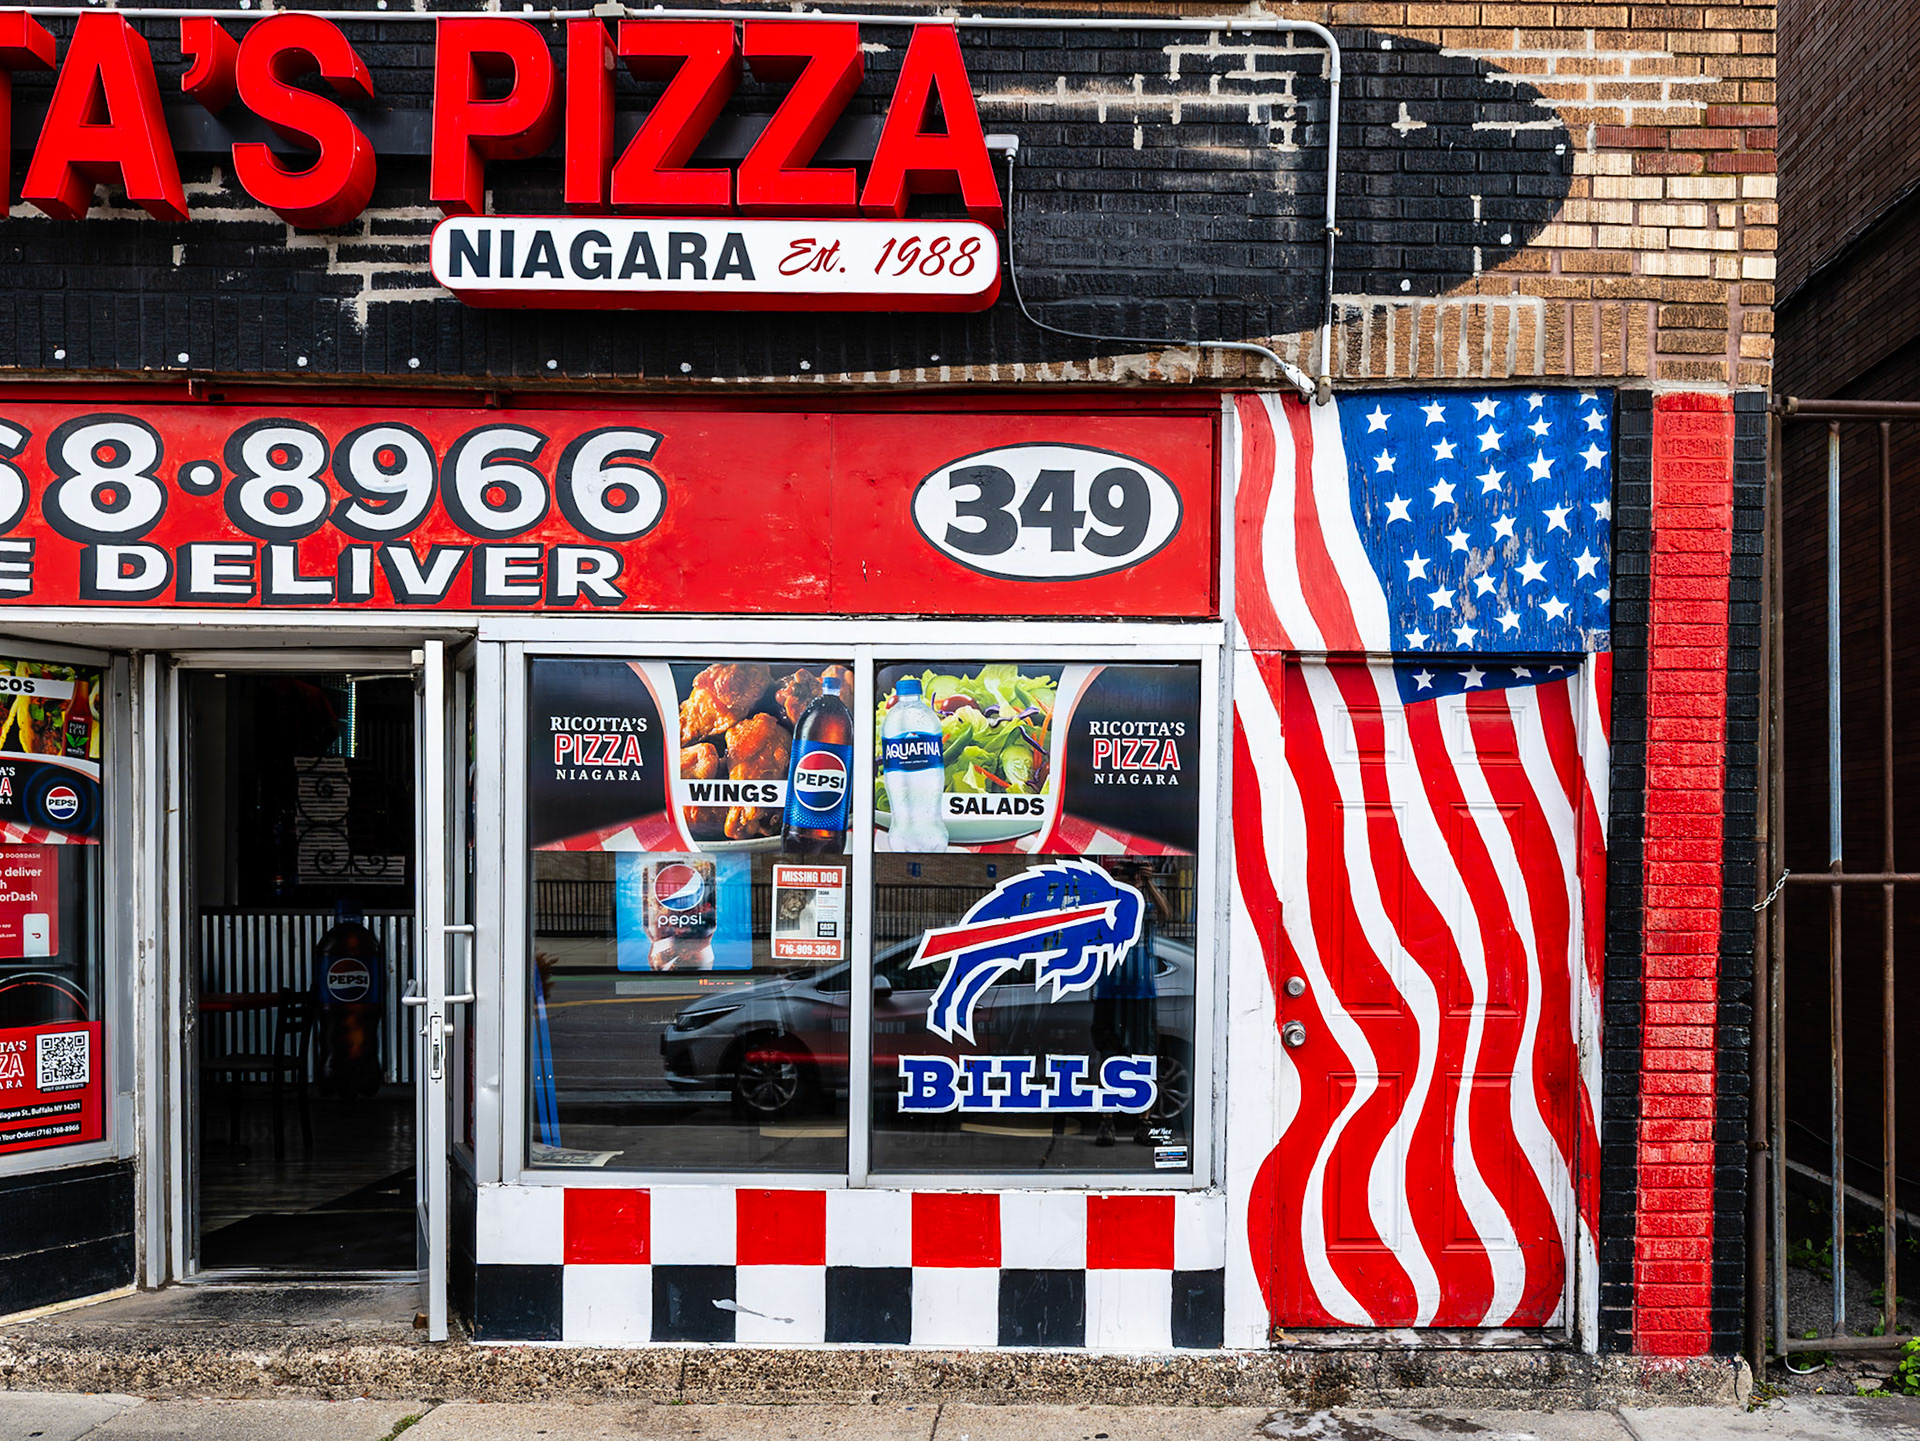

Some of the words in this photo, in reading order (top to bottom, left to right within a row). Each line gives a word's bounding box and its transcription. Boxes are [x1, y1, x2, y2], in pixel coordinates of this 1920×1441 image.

[0, 11, 377, 224] A'S
[430, 17, 1004, 218] PIZZA
[448, 228, 755, 281] NIAGARA
[778, 238, 846, 276] Est.
[873, 235, 981, 278] 1988
[944, 465, 1151, 557] 349
[79, 539, 627, 605] DELIVER
[550, 716, 647, 732] RICOTTA'S
[1089, 720, 1185, 736] RICOTTA'S
[554, 733, 643, 767] PIZZA
[886, 741, 940, 760] AQUAFINA
[1092, 738, 1181, 771] PIZZA
[556, 769, 641, 781] NIAGARA
[795, 770, 845, 789] PEPSI
[1094, 773, 1179, 785] NIAGARA
[689, 783, 778, 803] WINGS
[48, 798, 76, 807] PEPSI
[949, 796, 1045, 815] SALADS
[4, 866, 43, 877] deliver
[782, 871, 818, 882] MISSING
[821, 872, 838, 882] DOG
[657, 912, 702, 929] pepsi
[780, 944, 836, 955] 716-909-3842
[328, 973, 369, 986] PEPSI
[898, 1054, 1158, 1114] BILLS
[31, 1105, 53, 1115] Buffalo
[54, 1104, 63, 1112] NY
